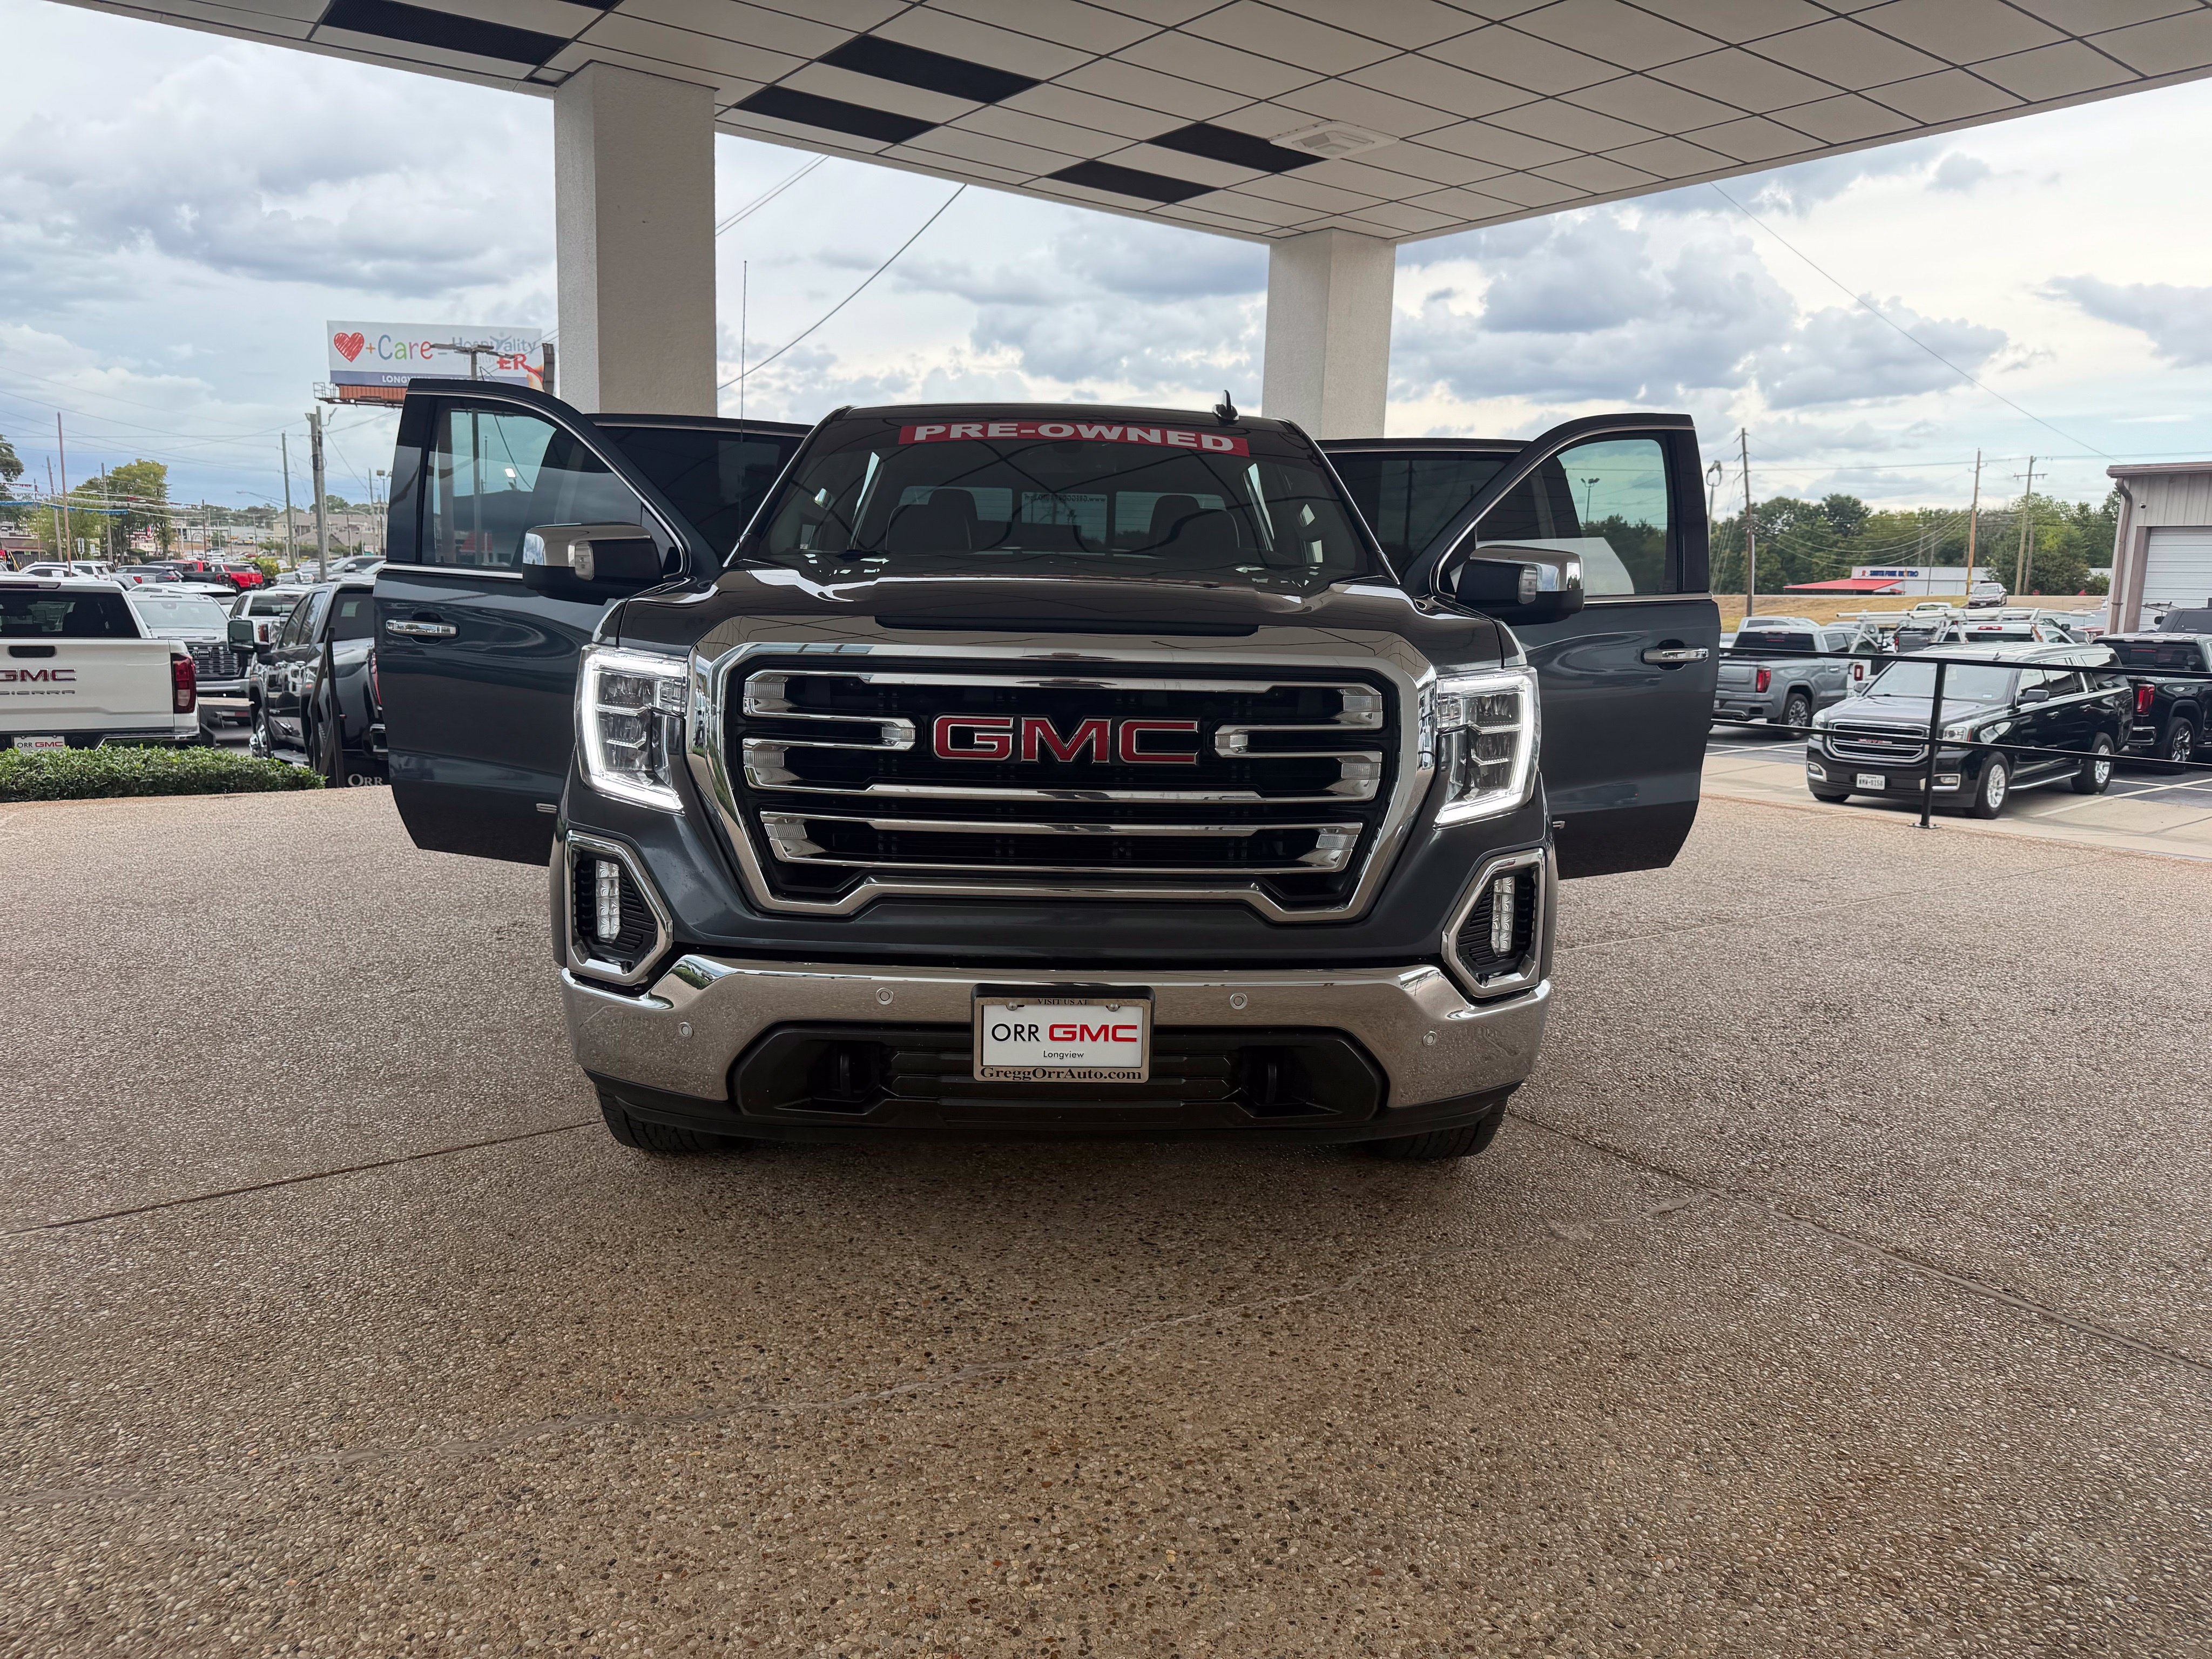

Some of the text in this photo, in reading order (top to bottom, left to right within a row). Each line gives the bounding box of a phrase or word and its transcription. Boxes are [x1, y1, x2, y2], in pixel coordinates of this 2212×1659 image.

[378, 334, 433, 361] Care
[914, 423, 1234, 452] PRE-OWNED
[0, 668, 77, 682] GMC
[933, 715, 1198, 765] GMC
[348, 773, 383, 787] ORR
[992, 1023, 1138, 1042] ORR GMC
[1043, 1050, 1084, 1060] Longview
[980, 1067, 1142, 1081] GreggOrrAuto.com
